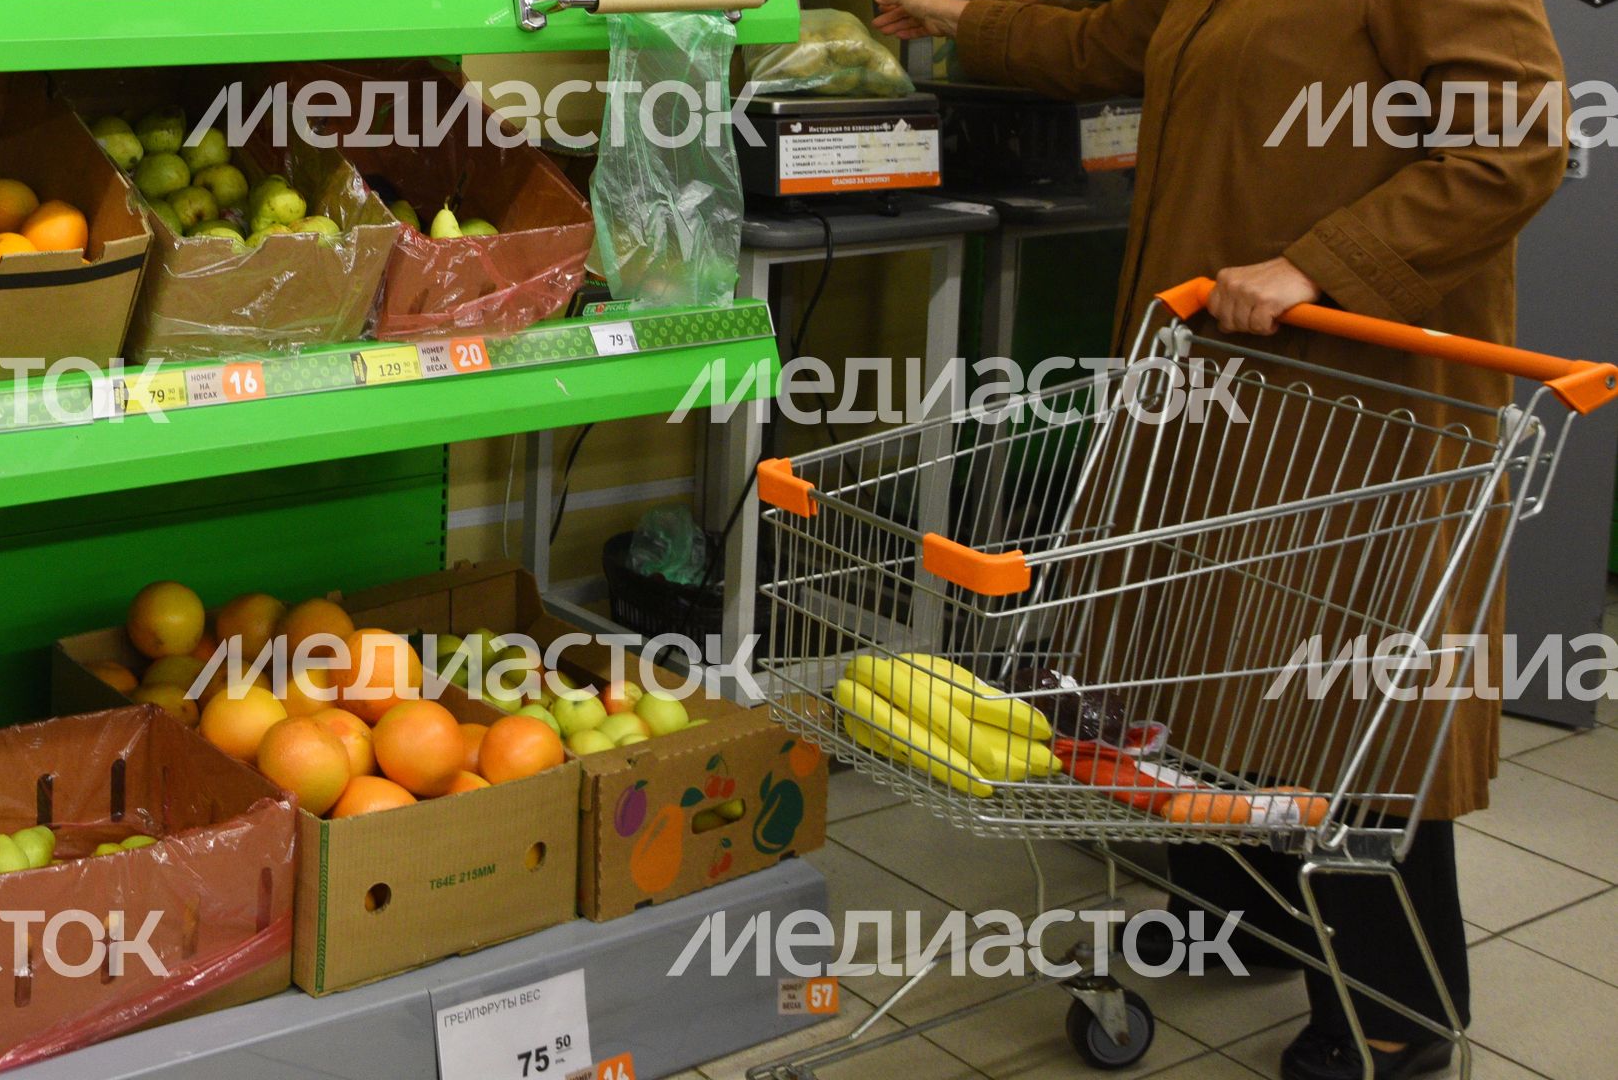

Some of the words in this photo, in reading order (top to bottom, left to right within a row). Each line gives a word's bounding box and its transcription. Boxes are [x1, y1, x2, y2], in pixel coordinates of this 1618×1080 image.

[609, 334, 624, 347] 79
[422, 346, 444, 355] НОМЕР
[455, 344, 483, 367] 20
[379, 362, 402, 377] 129
[426, 363, 448, 372] ВЕСАХ
[191, 373, 216, 382] НОМЕР
[229, 370, 258, 395] 16
[199, 382, 210, 390] НА
[149, 389, 165, 404] 79
[193, 392, 218, 401] ВЕСАХ
[429, 873, 456, 891] T64E
[459, 863, 496, 884] 215MM
[811, 983, 833, 1008] 57
[444, 995, 517, 1028] ГРЕЙПФРУТЫ
[520, 989, 541, 1005] ВЕС
[555, 1035, 571, 1050] 50
[517, 1046, 550, 1078] 75
